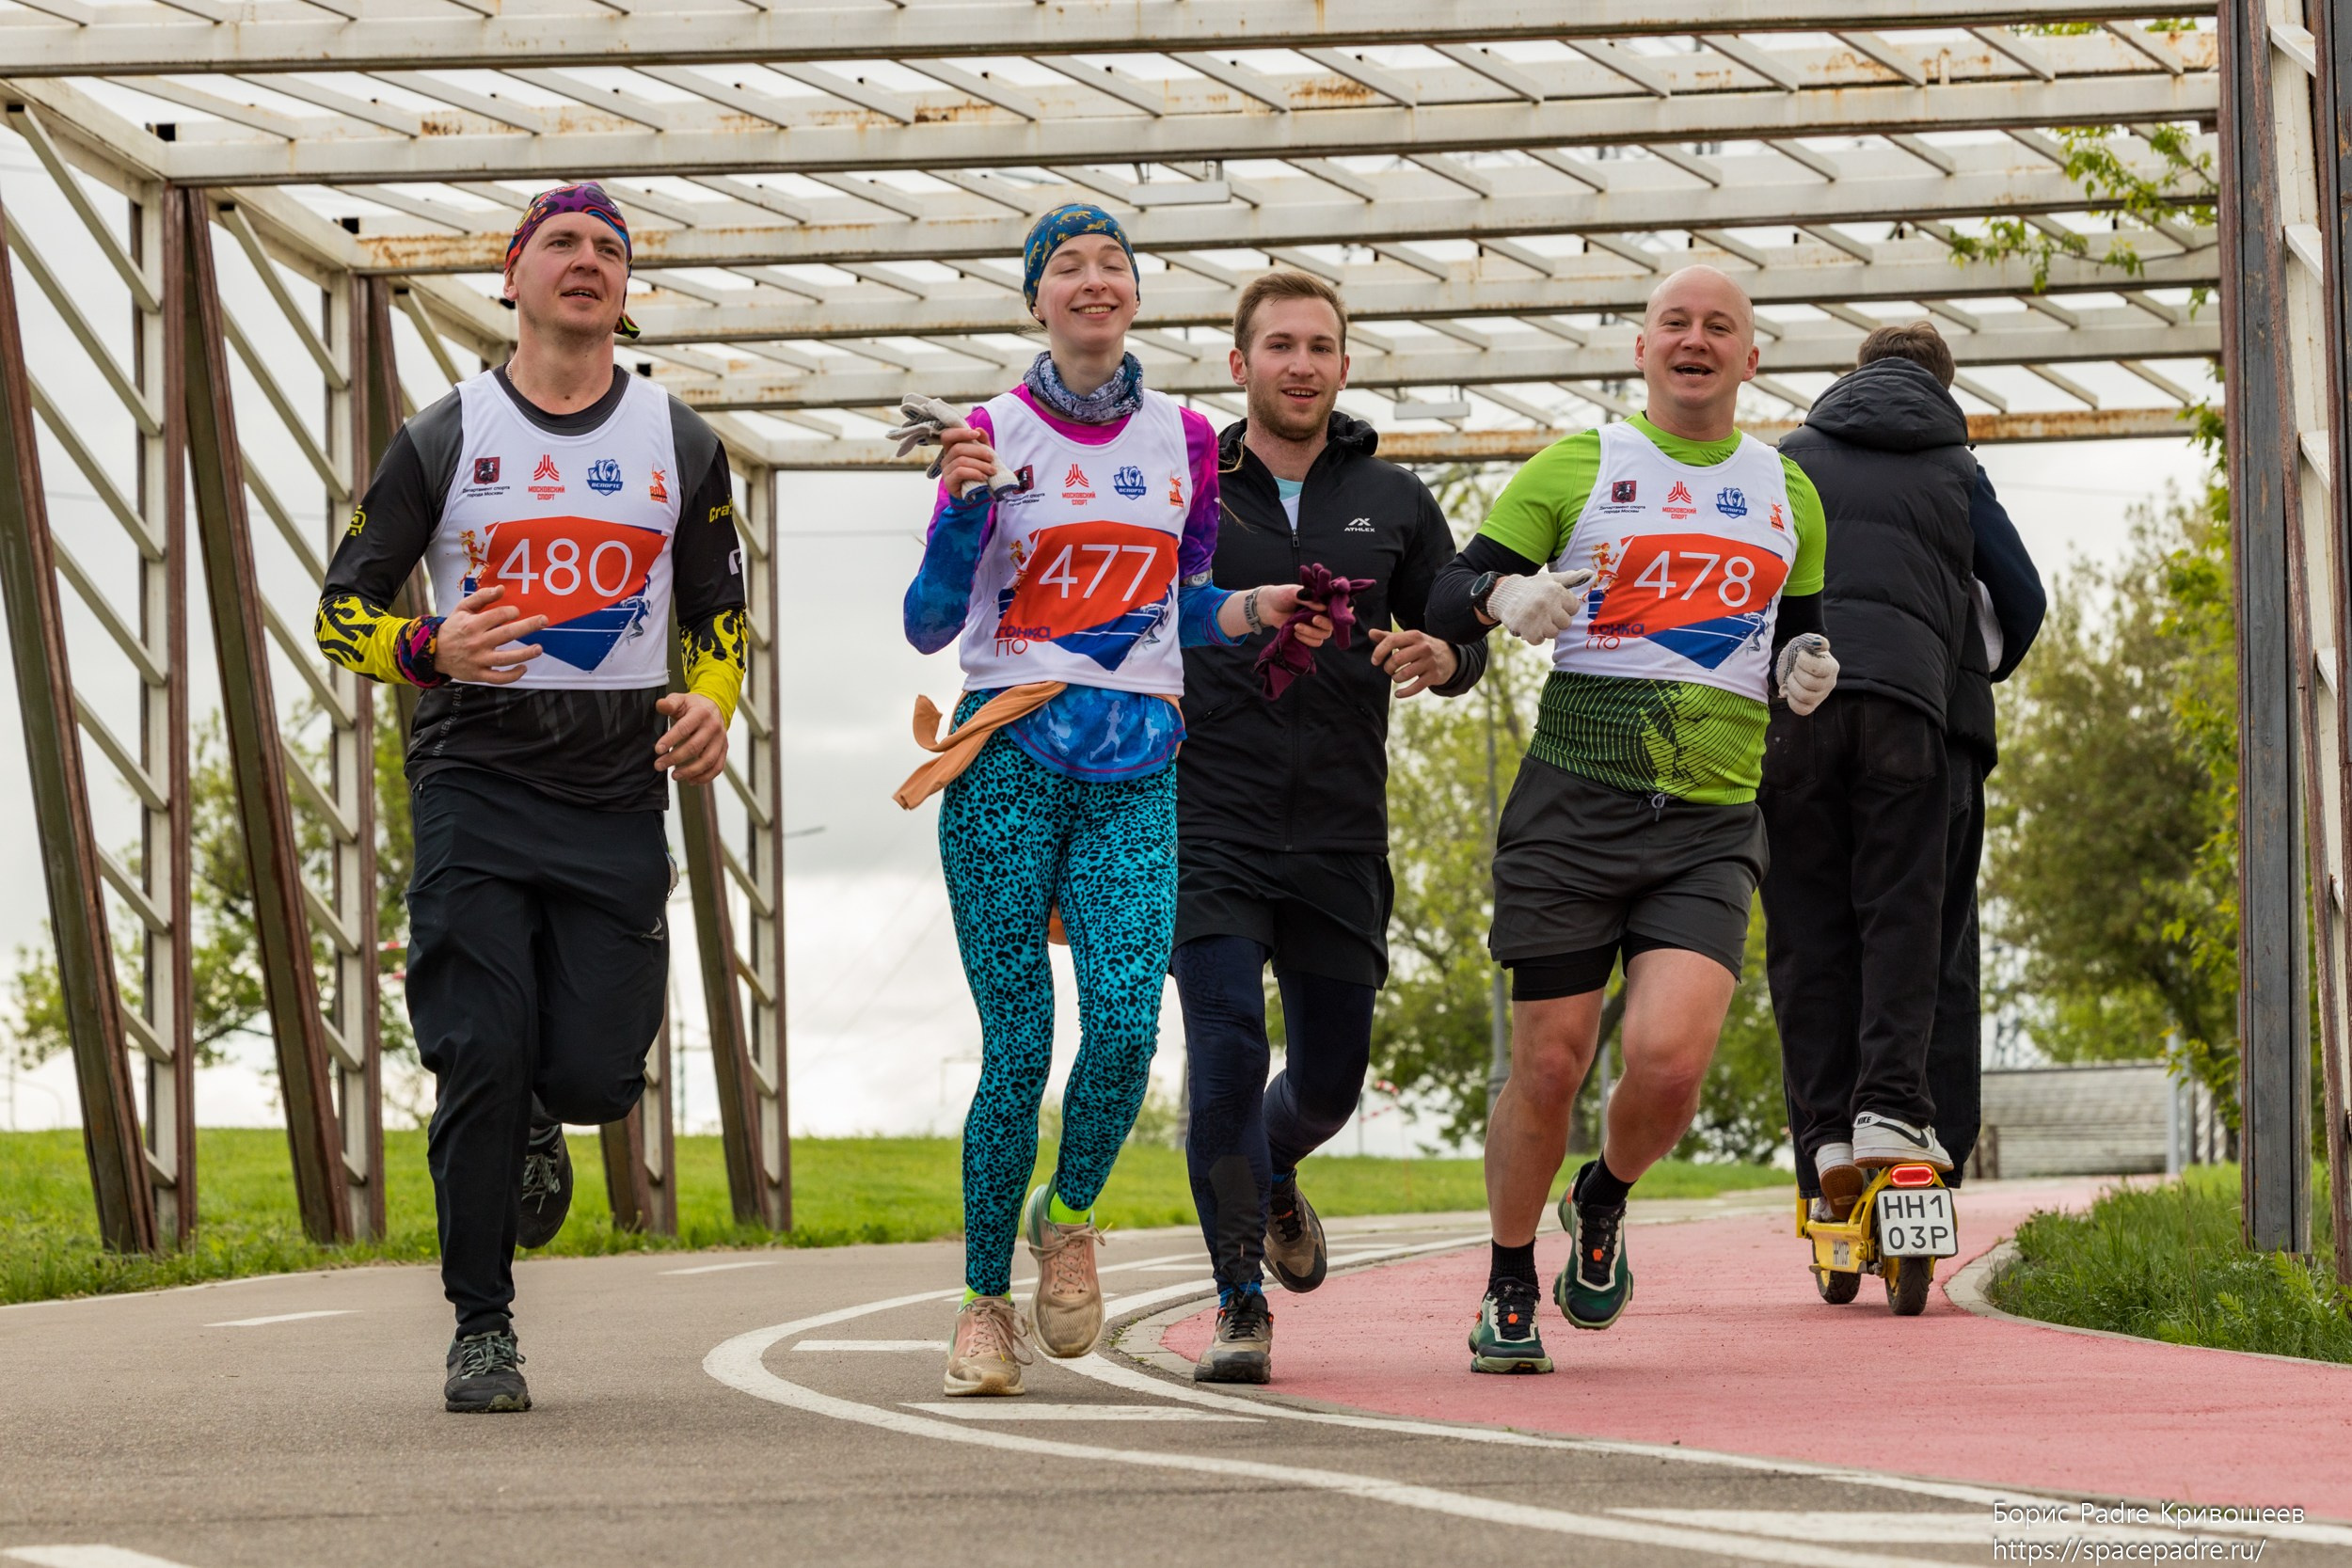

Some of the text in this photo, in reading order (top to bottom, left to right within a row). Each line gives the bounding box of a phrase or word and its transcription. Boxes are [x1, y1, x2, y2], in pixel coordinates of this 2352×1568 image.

[528, 485, 565, 494] МОСКОВСКИЙ
[1661, 506, 1697, 515] МОСКОВСКИЙ
[497, 537, 633, 597] 480
[1038, 544, 1158, 602] 477
[1633, 550, 1756, 608] 478
[995, 639, 1028, 657] ГТО
[1585, 636, 1621, 650] ГТО
[1856, 1116, 1872, 1126] NIKE
